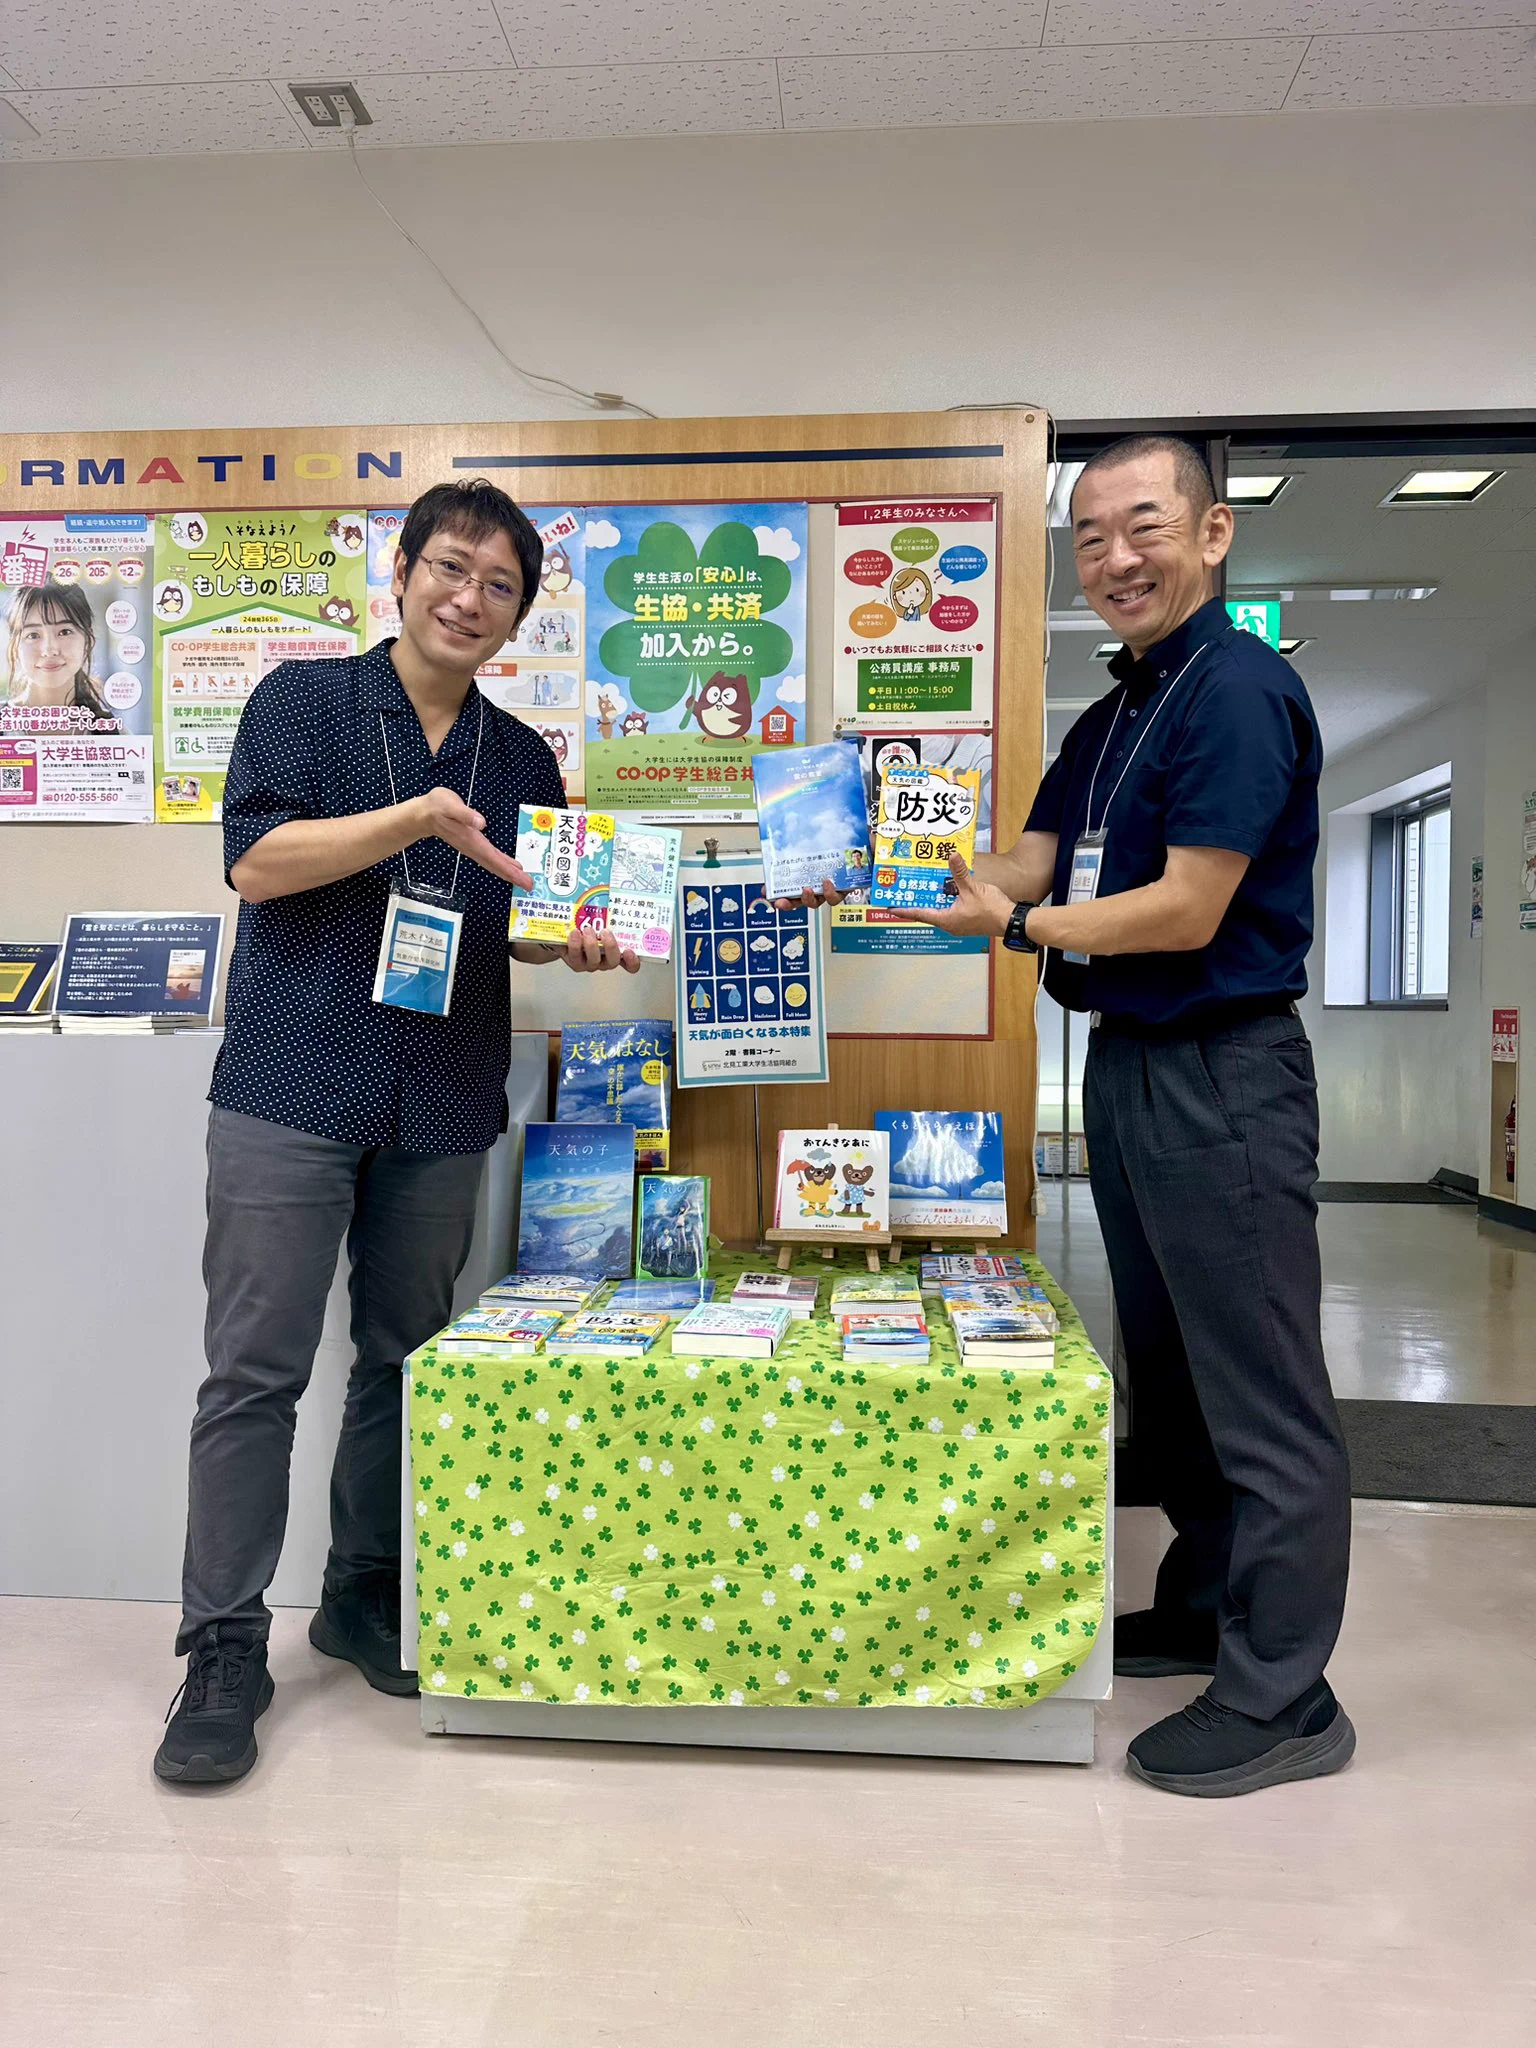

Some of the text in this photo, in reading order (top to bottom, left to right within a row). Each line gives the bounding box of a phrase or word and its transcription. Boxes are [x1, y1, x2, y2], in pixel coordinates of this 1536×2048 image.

[0, 451, 402, 486] RMATION
[863, 506, 969, 519] 1,2年生のみなさんへ
[236, 525, 287, 536] そなえよう
[188, 541, 336, 571] 一人暮らしの
[633, 566, 763, 585] 学生生活の「安心」は、
[192, 571, 329, 597] もしもの保障
[633, 592, 762, 622] 生協・共済
[211, 626, 312, 634] 一人暮らしのもしもをサポート!
[267, 641, 347, 652] 学生賠償責任保険
[639, 632, 754, 659] 加入から。
[869, 661, 960, 674] 公務員講座 事務局
[2, 707, 96, 718] 大学生のお困りごと、
[876, 702, 917, 711] 土日祝休み
[42, 746, 146, 761] 大学生協窓口へ!
[645, 755, 743, 763] 大学生には大学生協の保障制度
[896, 791, 971, 824] 防災の
[554, 815, 575, 887] 天気の図鑑
[898, 879, 939, 891] 自然災害
[688, 1026, 811, 1041] 天気が面白くなる本特集
[723, 1059, 797, 1069] 北見工業大学生活協同組合
[803, 1138, 870, 1147] おてんきなあに
[549, 1144, 609, 1156] 天気の子
